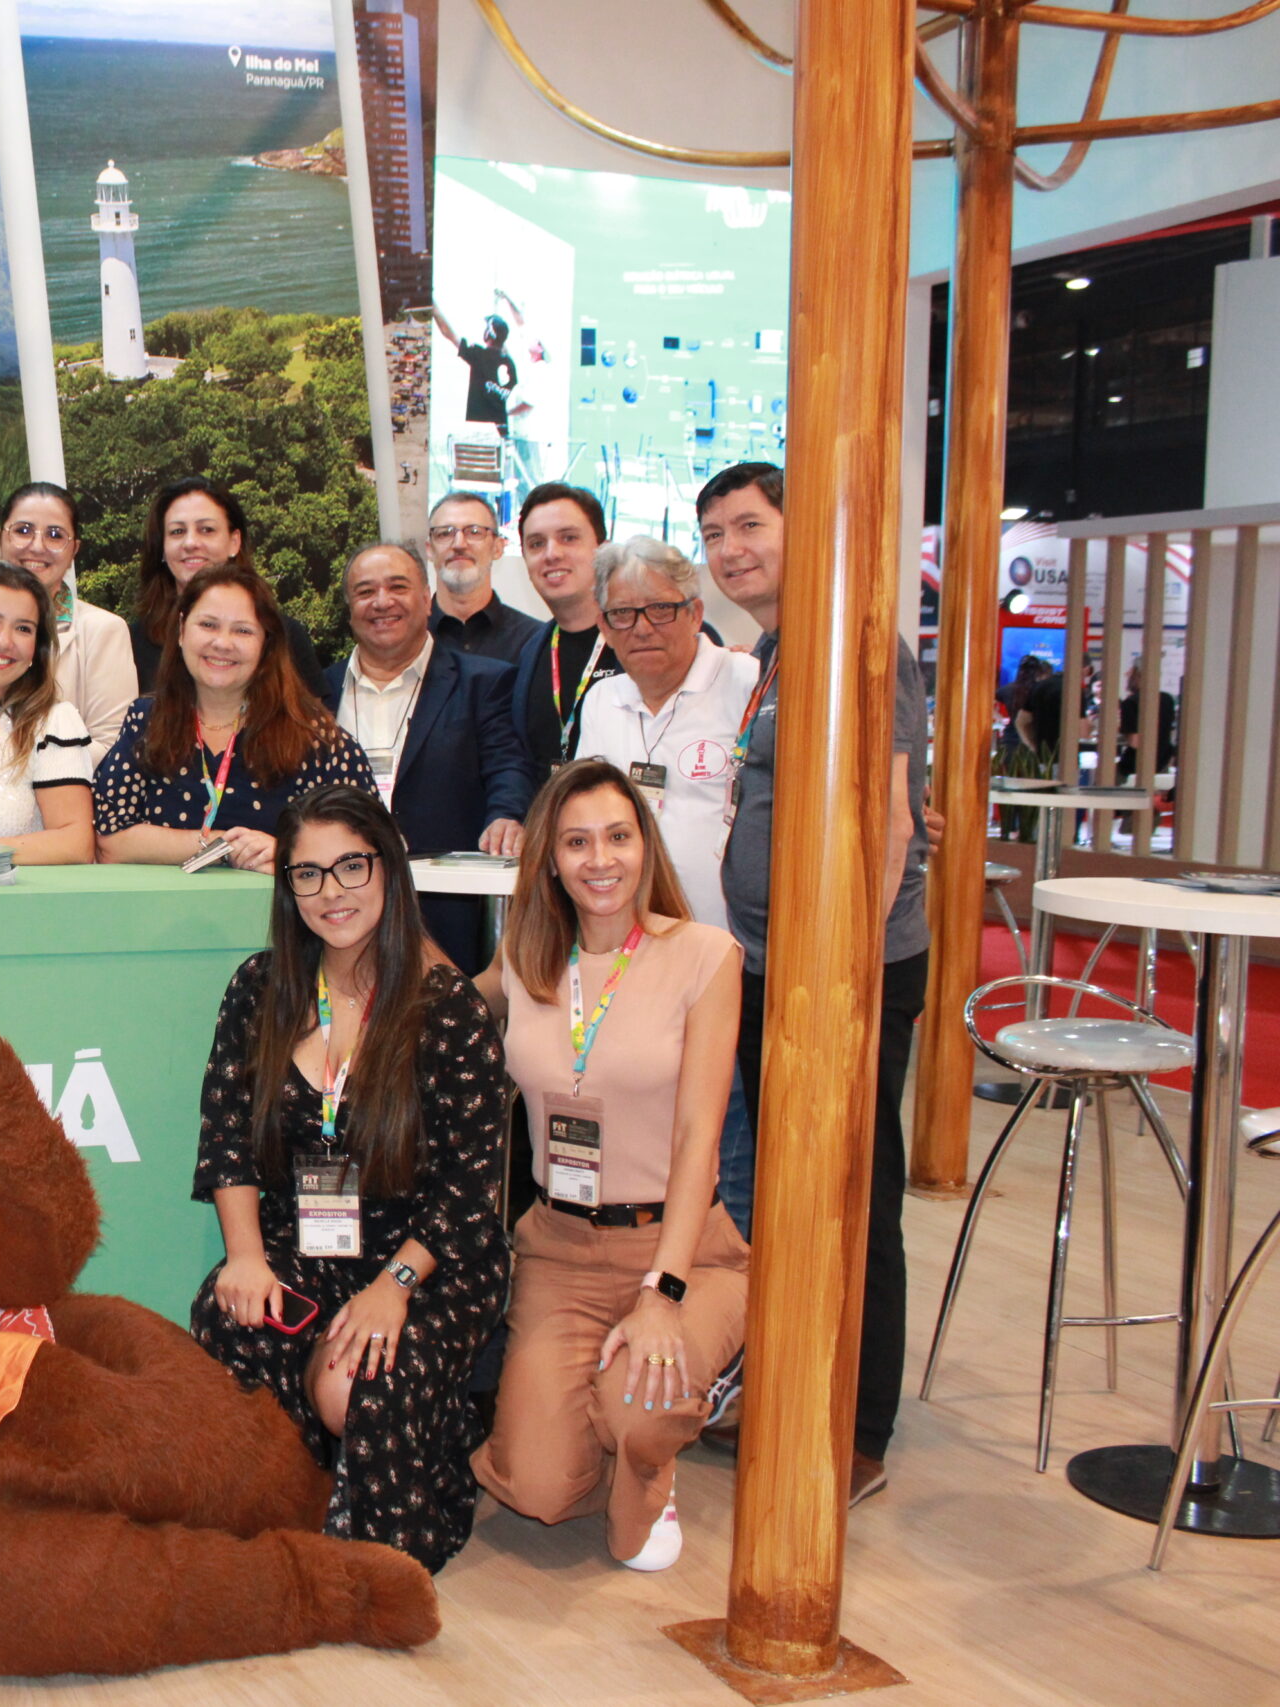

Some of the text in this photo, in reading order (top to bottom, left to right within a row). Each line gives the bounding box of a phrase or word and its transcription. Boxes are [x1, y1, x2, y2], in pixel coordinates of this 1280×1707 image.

[245, 54, 320, 73] Ilha do Mel
[246, 73, 325, 90] Paranaguá/PR
[1034, 569, 1069, 585] USA
[308, 1210, 348, 1218] EXPOSITOR
